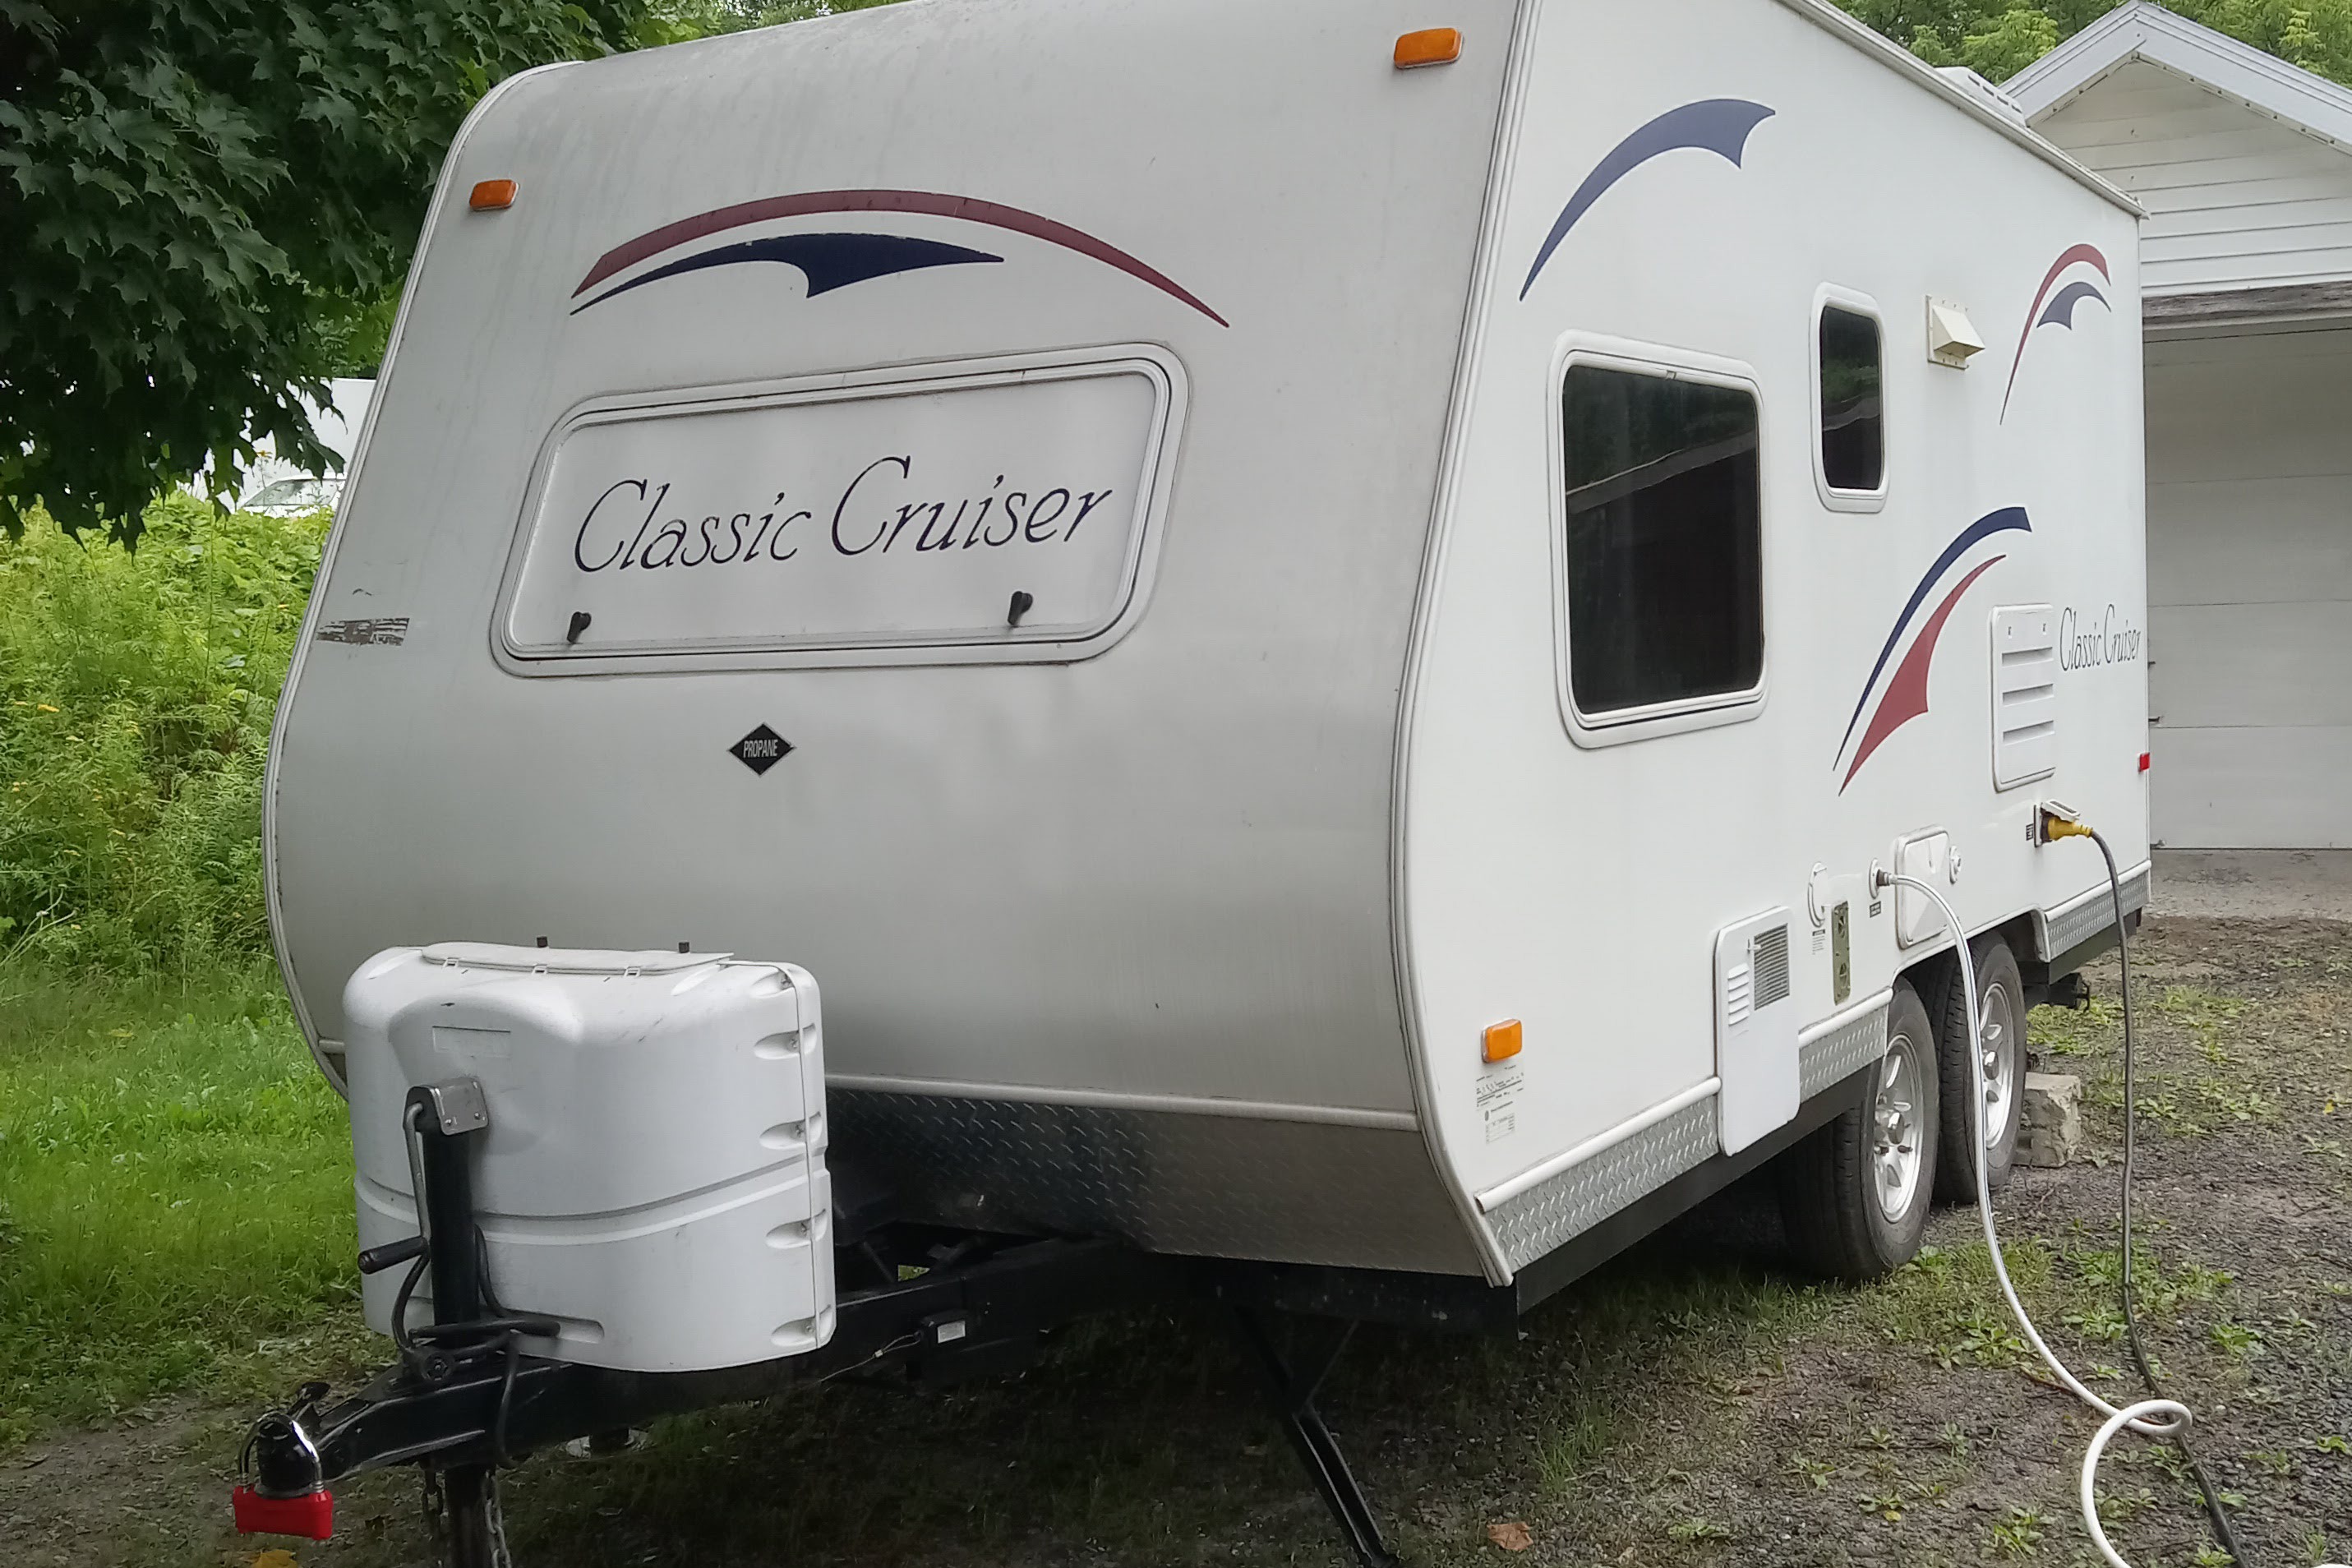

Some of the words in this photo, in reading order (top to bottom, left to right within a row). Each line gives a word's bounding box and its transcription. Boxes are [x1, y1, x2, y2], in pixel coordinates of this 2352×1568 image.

[573, 478, 812, 574] Classic
[831, 455, 1114, 557] Cruiser
[2059, 606, 2102, 671] Classic
[2104, 603, 2142, 664] Cruiser
[743, 739, 778, 759] PROPANE
